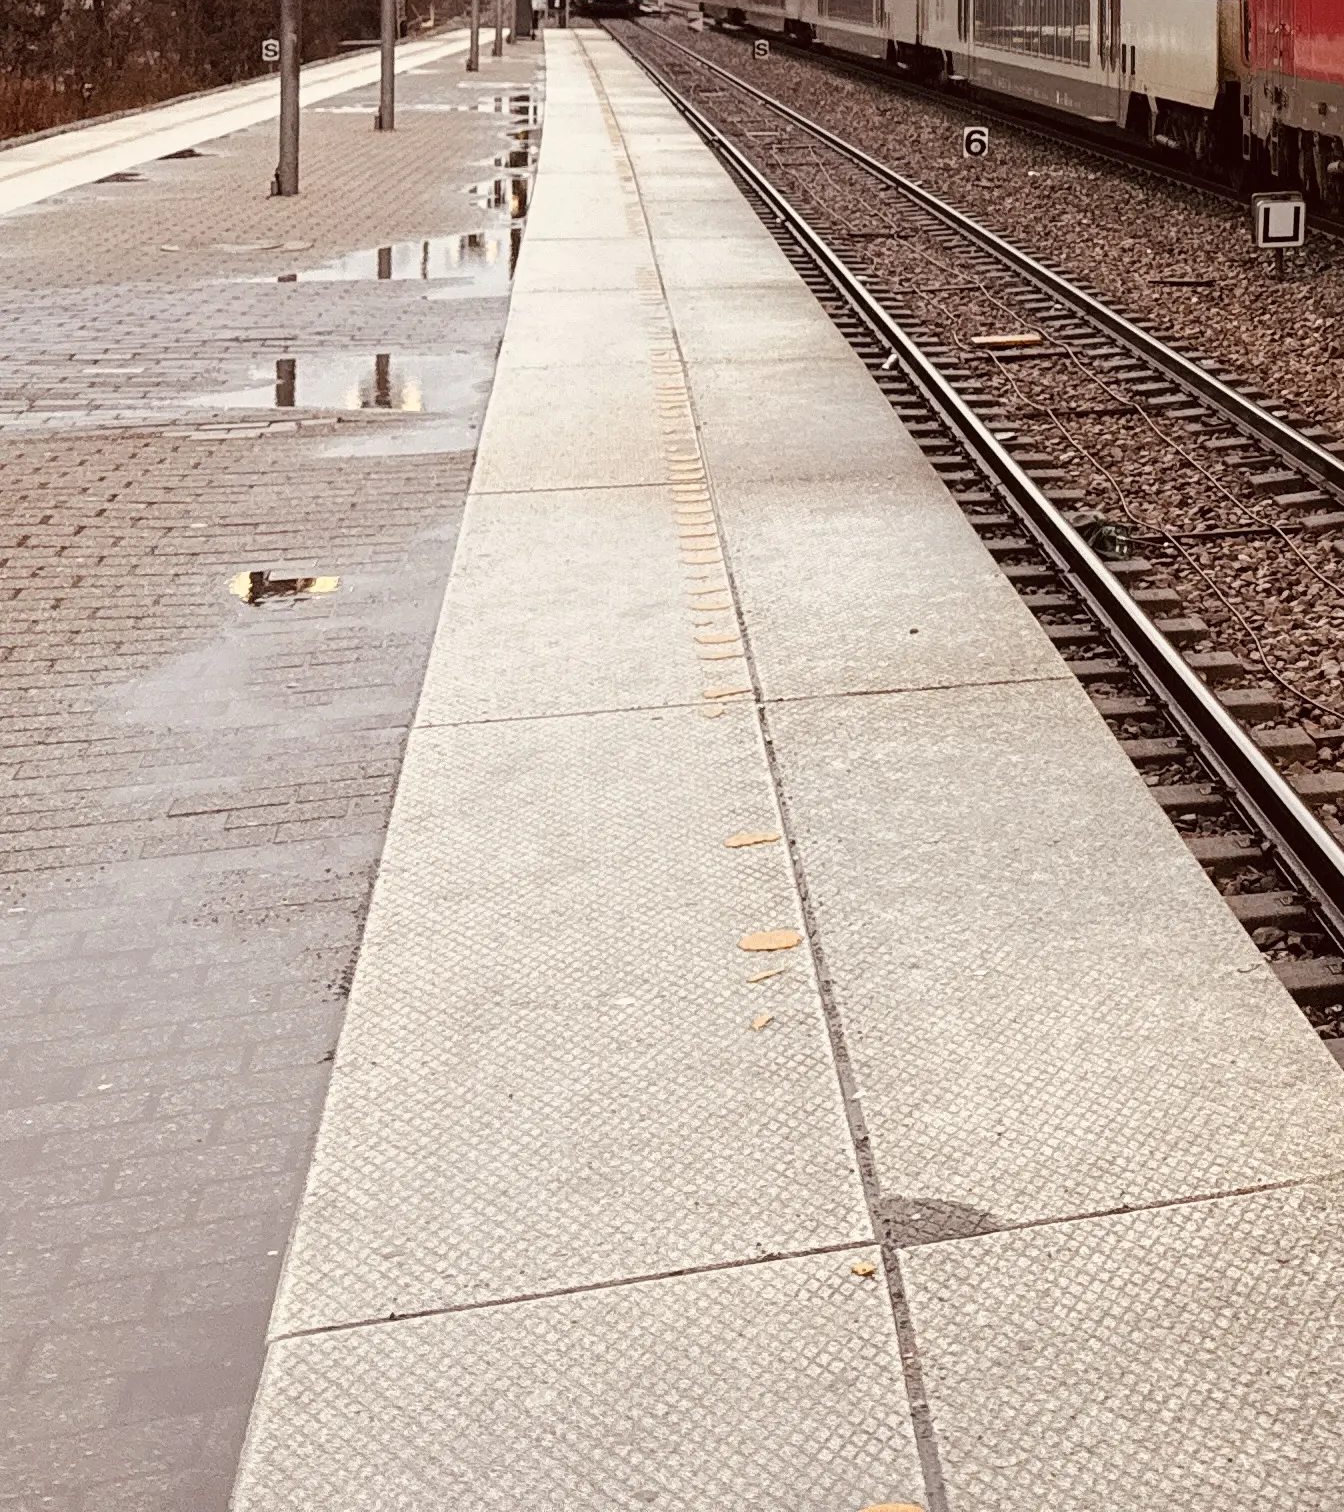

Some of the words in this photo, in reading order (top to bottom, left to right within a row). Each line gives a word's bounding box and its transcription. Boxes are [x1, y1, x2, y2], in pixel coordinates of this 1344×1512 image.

[264, 42, 279, 58] S
[755, 42, 768, 57] S
[965, 129, 987, 157] 6
